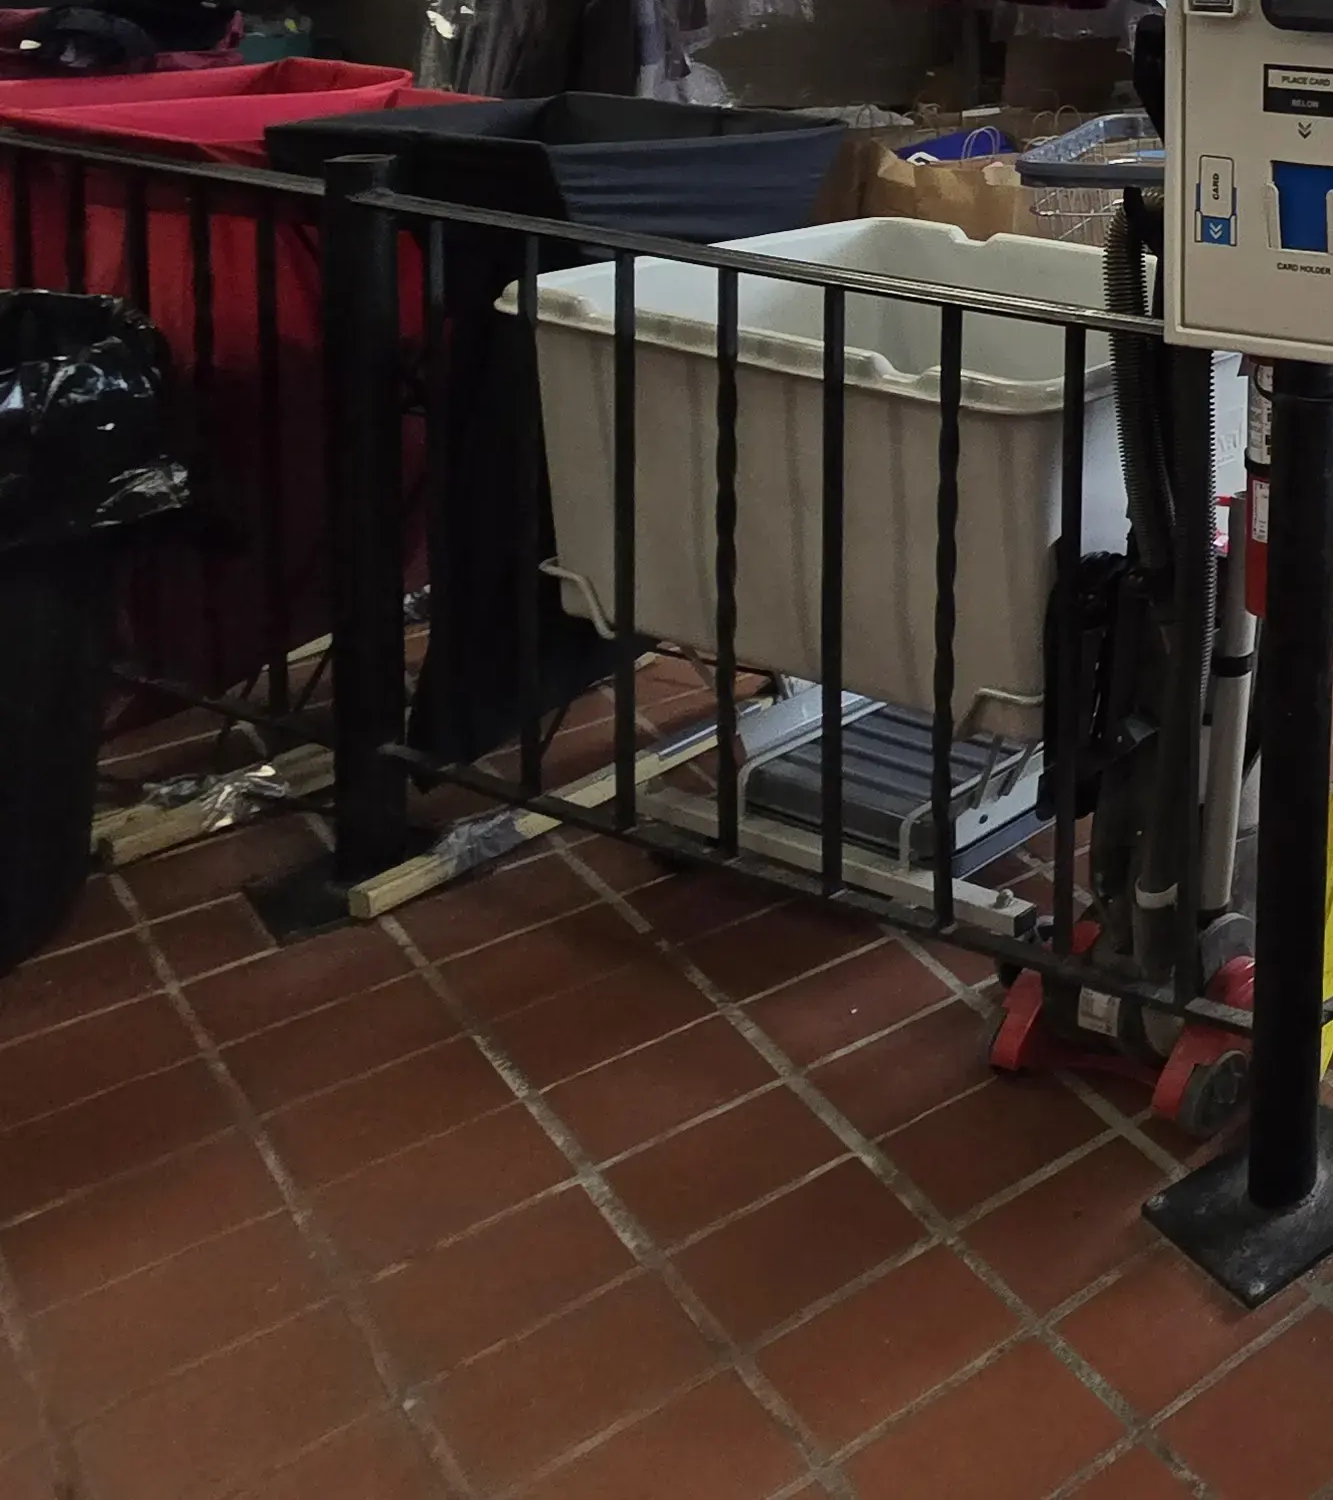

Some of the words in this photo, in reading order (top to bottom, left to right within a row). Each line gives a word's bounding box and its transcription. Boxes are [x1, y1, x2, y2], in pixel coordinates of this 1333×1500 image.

[1282, 75, 1308, 86] PLACE
[1309, 77, 1331, 87] CARD
[1212, 172, 1220, 200] CARD
[1277, 262, 1299, 272] CARD
[1300, 264, 1331, 275] HOLDER
